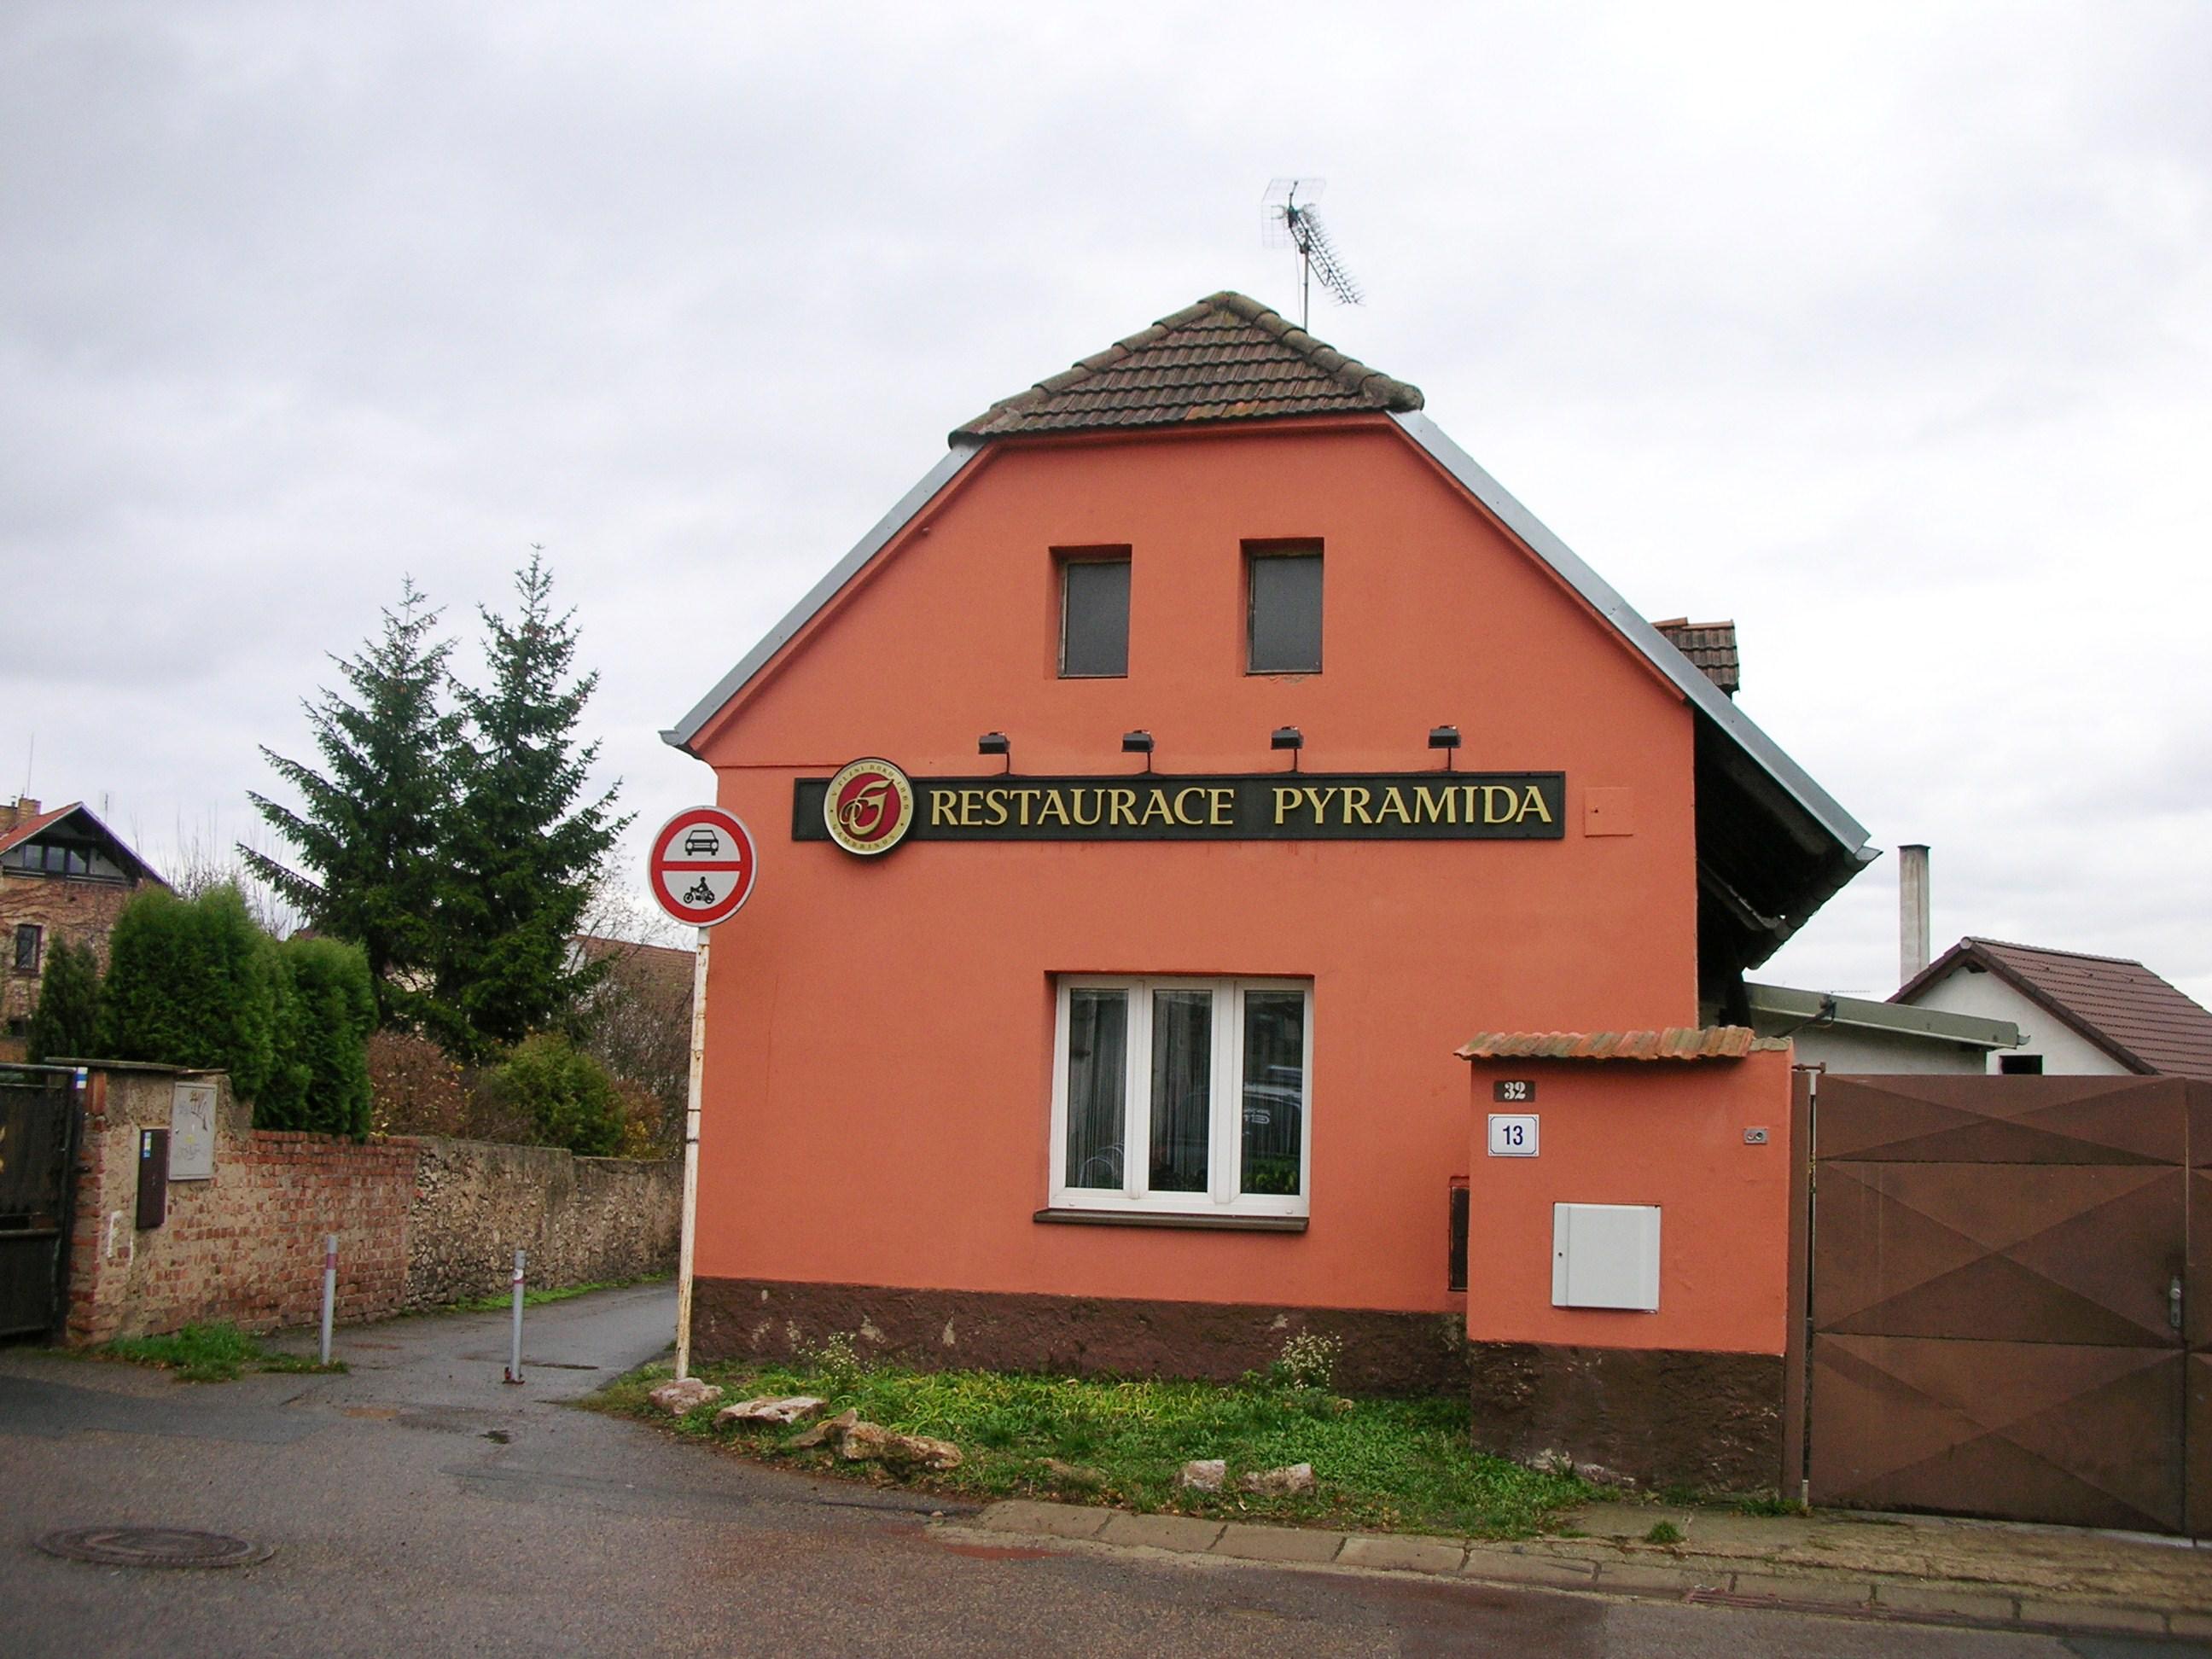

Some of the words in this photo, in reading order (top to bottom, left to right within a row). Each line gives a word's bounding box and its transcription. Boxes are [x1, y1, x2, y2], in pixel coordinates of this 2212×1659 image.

[929, 787, 1235, 826] RESTAURACE
[1272, 785, 1552, 825] PYRAMIDA
[1504, 1081, 1526, 1100] 32
[1502, 1125, 1523, 1145] 13
